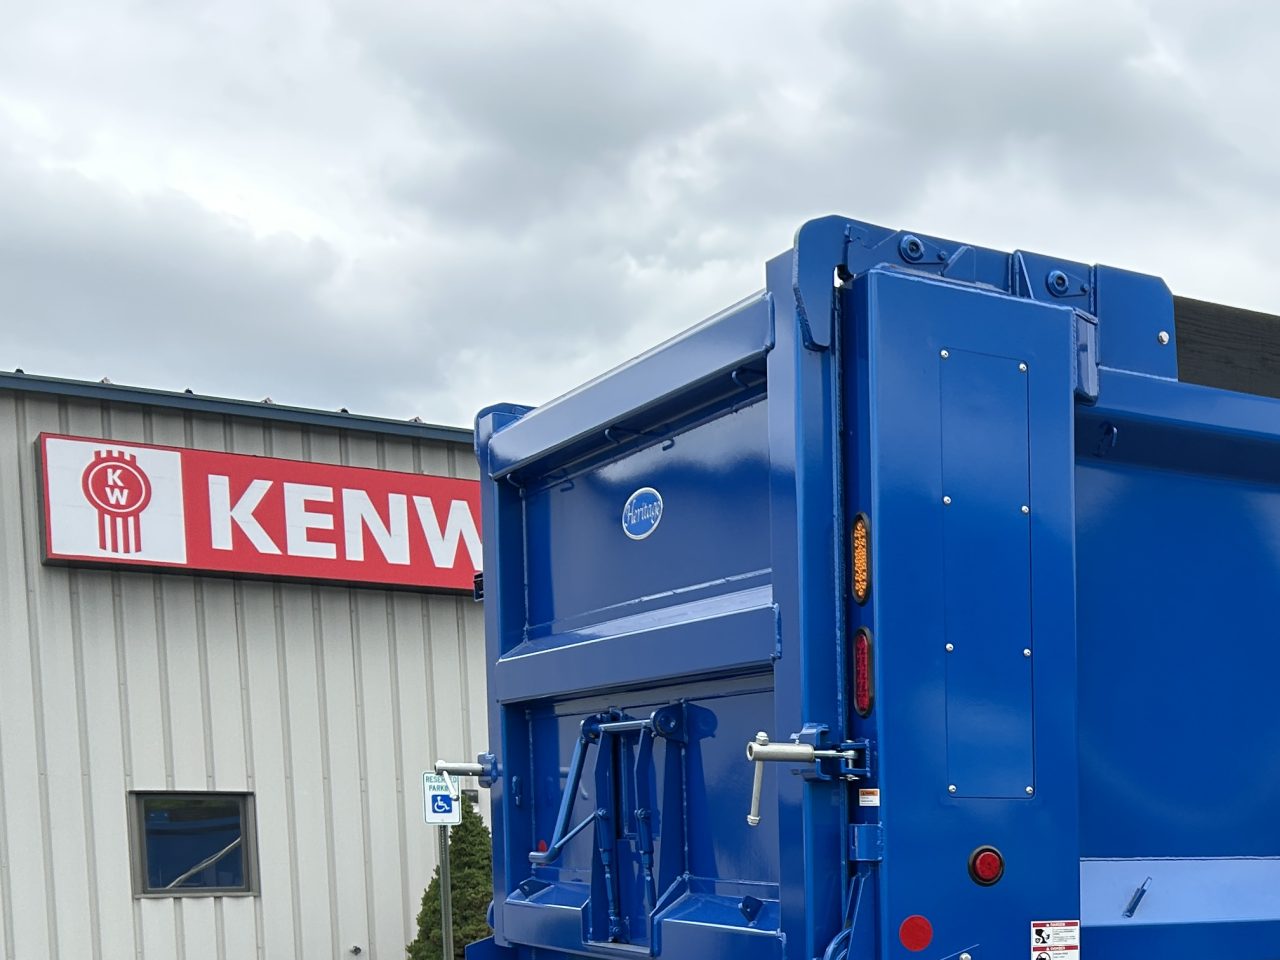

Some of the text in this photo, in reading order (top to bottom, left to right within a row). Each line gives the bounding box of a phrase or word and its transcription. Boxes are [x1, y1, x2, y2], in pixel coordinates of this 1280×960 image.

[107, 468, 123, 487] K
[105, 487, 128, 505] W
[207, 474, 482, 570] KENW
[625, 499, 660, 527] Heritage
